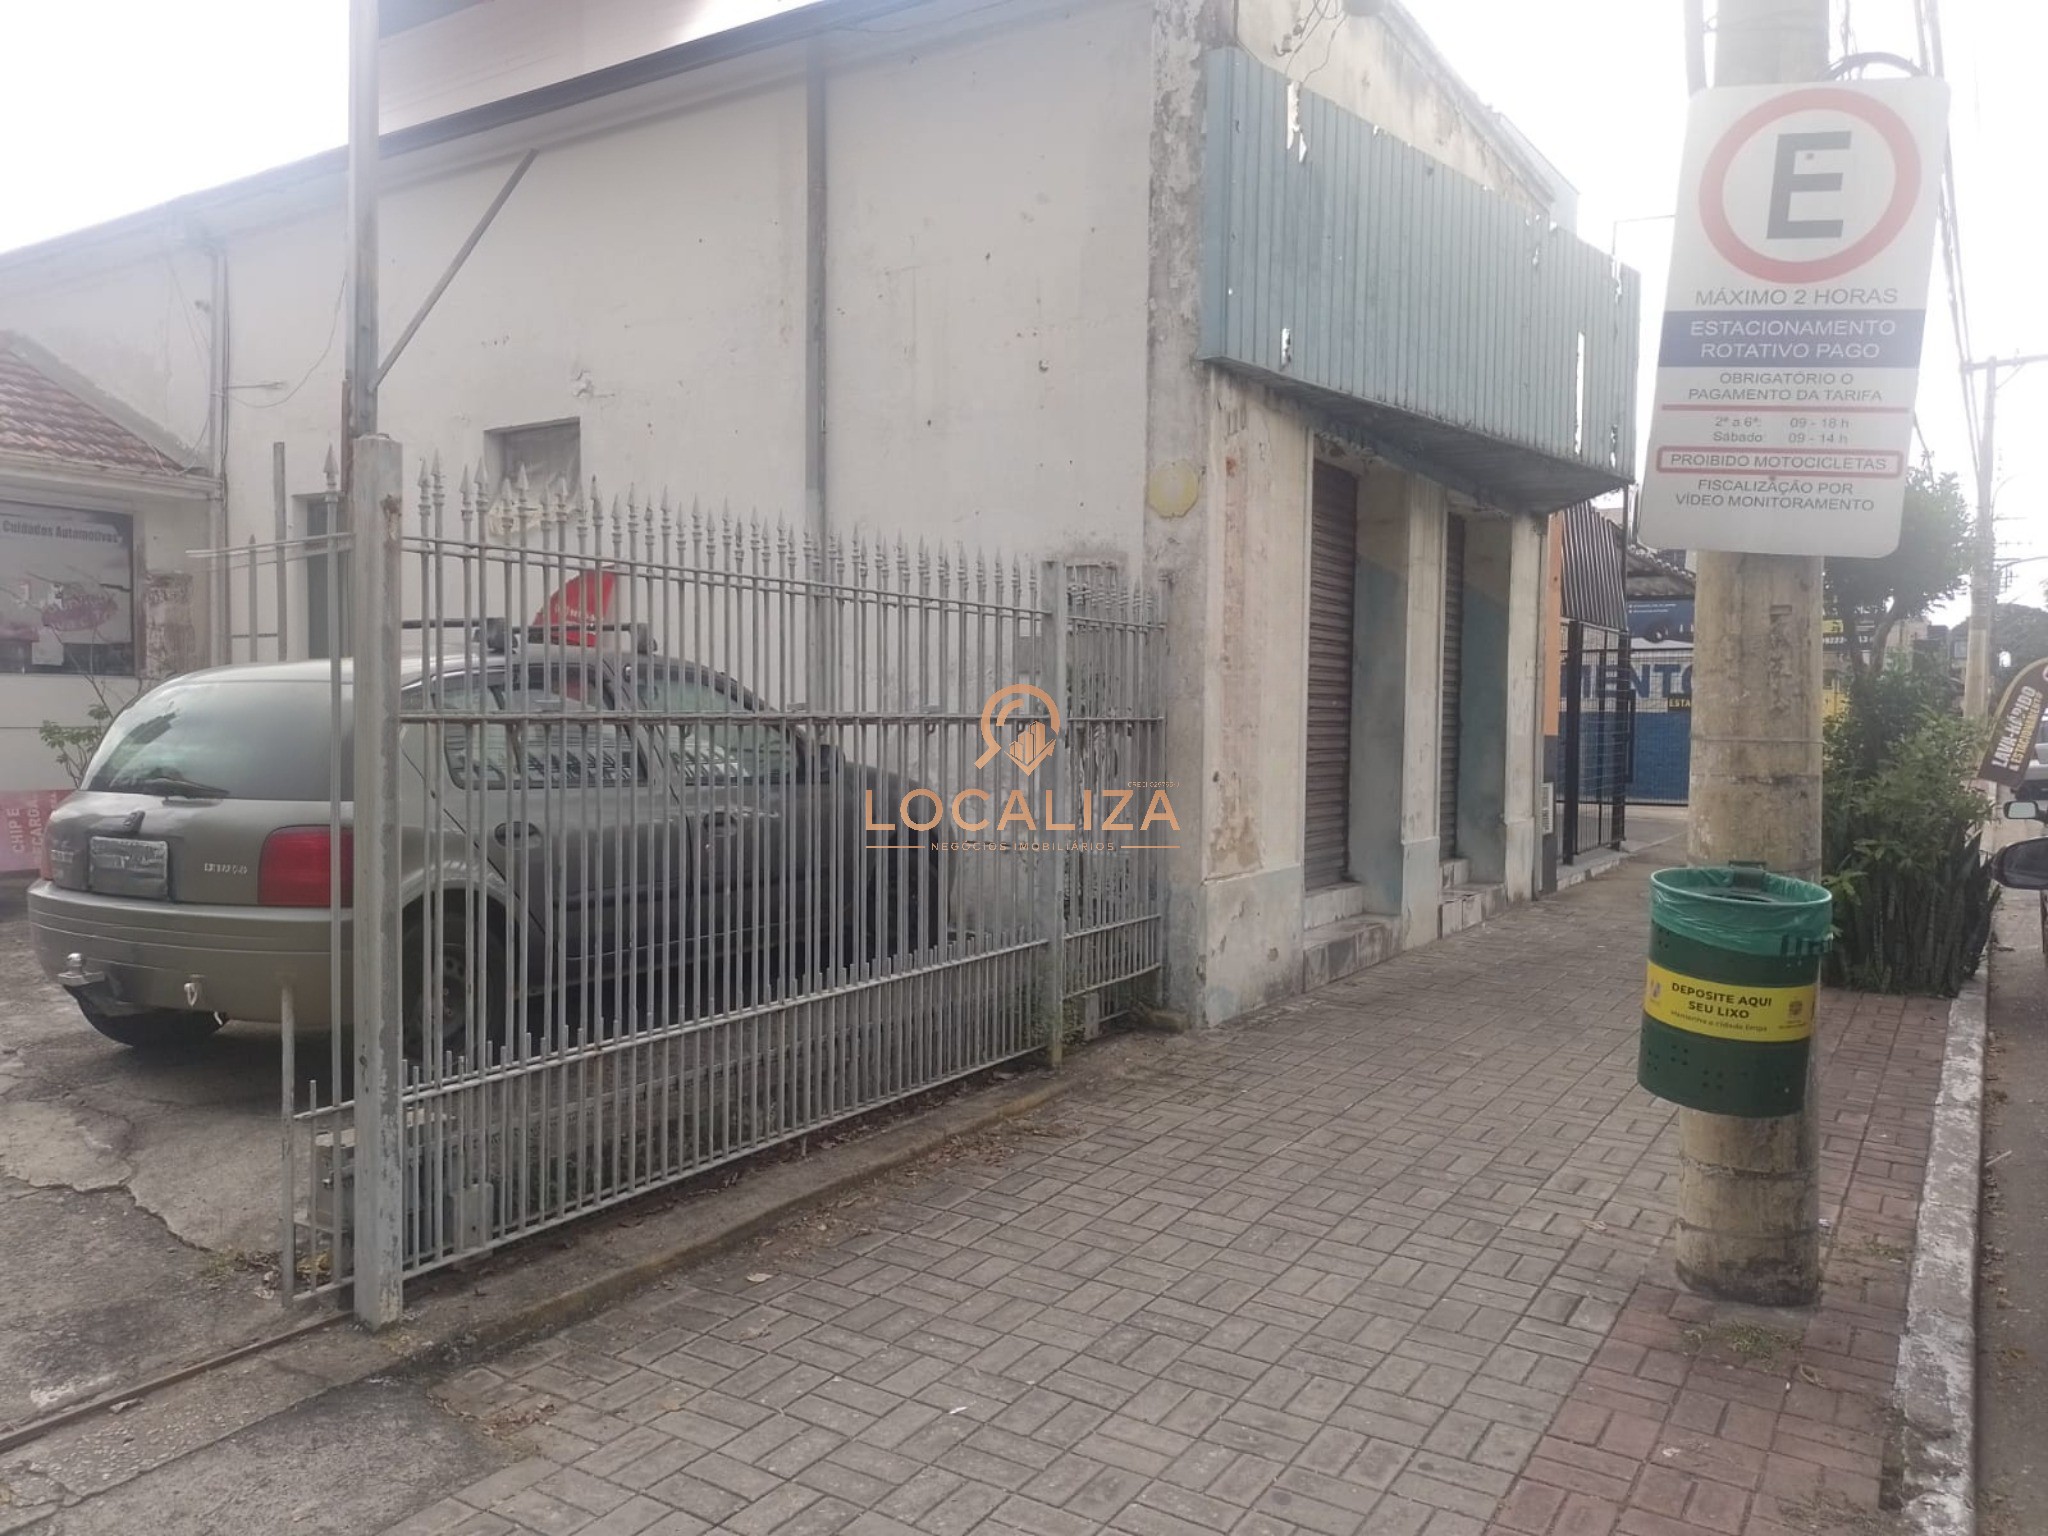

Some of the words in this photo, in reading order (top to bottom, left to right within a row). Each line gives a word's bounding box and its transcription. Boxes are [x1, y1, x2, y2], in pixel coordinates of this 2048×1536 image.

[1766, 131, 1852, 239] E
[1695, 287, 1788, 306] MÁXIMO
[1794, 289, 1806, 305] 2
[1814, 287, 1899, 305] HORAS
[1690, 320, 1896, 336] ESTACIONAMENTO
[1700, 343, 1811, 359] ROTATIVO
[1816, 343, 1881, 359] PAGO
[1719, 370, 1836, 385] OBRIGATÓRIO
[1841, 372, 1854, 385] O
[1688, 388, 1792, 401] PAGAMENTO
[1796, 389, 1823, 401] DA
[1823, 389, 1882, 402] TARIFA
[1789, 417, 1807, 428] 09
[1822, 417, 1837, 429] 18
[1788, 432, 1805, 444] 09
[1821, 433, 1834, 444] 14
[1670, 454, 1750, 468] PROIBIDO
[1754, 455, 1887, 471] MOTOCICLETAS
[1697, 479, 1813, 495] FISCALIZAÇÃO
[1818, 482, 1854, 495] POR
[1675, 492, 1724, 507] VÍDEO
[1727, 495, 1875, 512] MONITORAMENTO
[8, 820, 26, 853] CHIP
[1671, 982, 1735, 1004] DEPOSITE
[1737, 996, 1772, 1007] AQUI
[1688, 1000, 1714, 1014] SEU
[1717, 1007, 1750, 1019] LIXO
